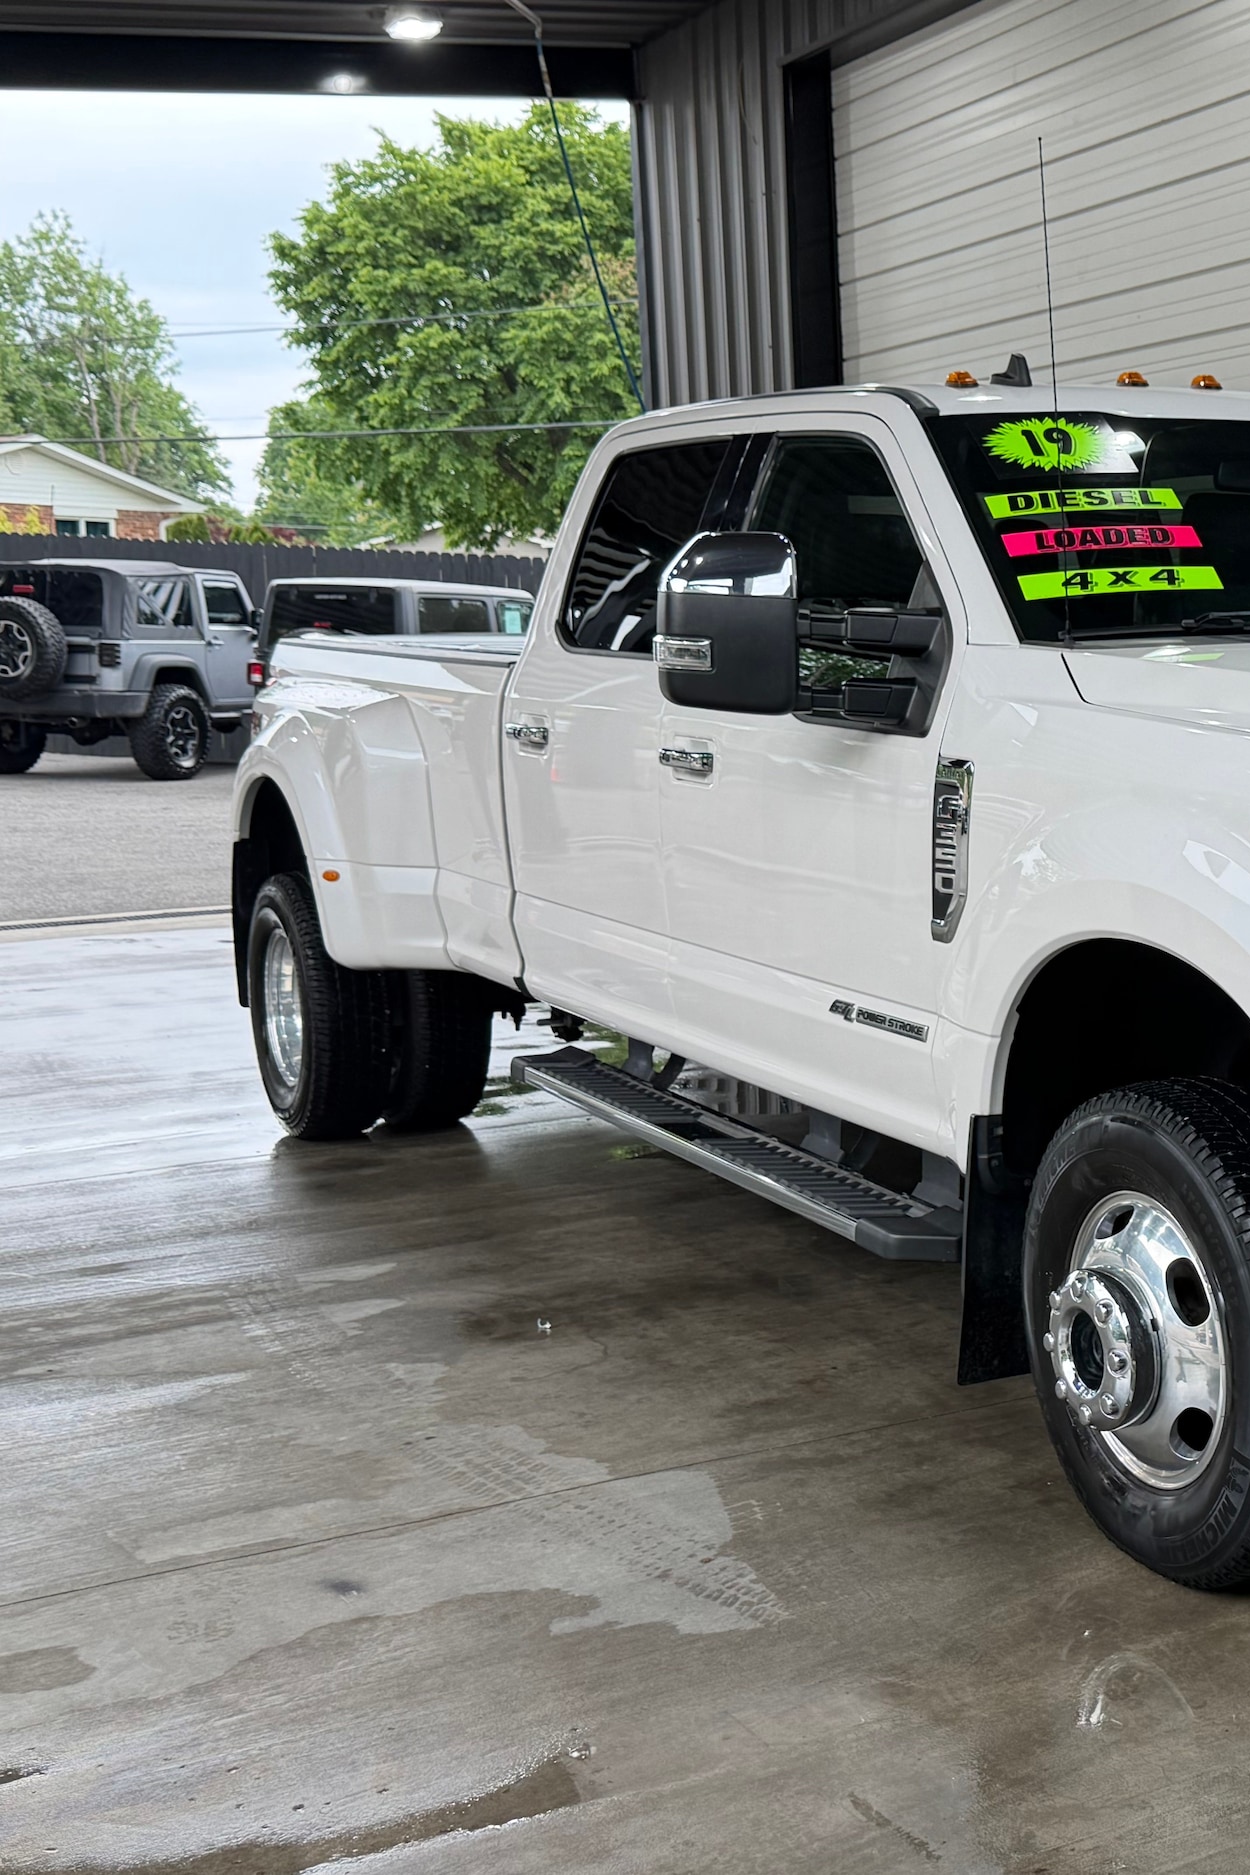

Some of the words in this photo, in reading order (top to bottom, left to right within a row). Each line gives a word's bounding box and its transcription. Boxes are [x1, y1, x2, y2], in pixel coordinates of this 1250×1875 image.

[1021, 427, 1077, 458] 19
[1007, 489, 1165, 512] DIESEL
[1035, 527, 1173, 552] LOADED
[857, 1008, 887, 1026] POWER
[887, 1018, 924, 1037] STROKE
